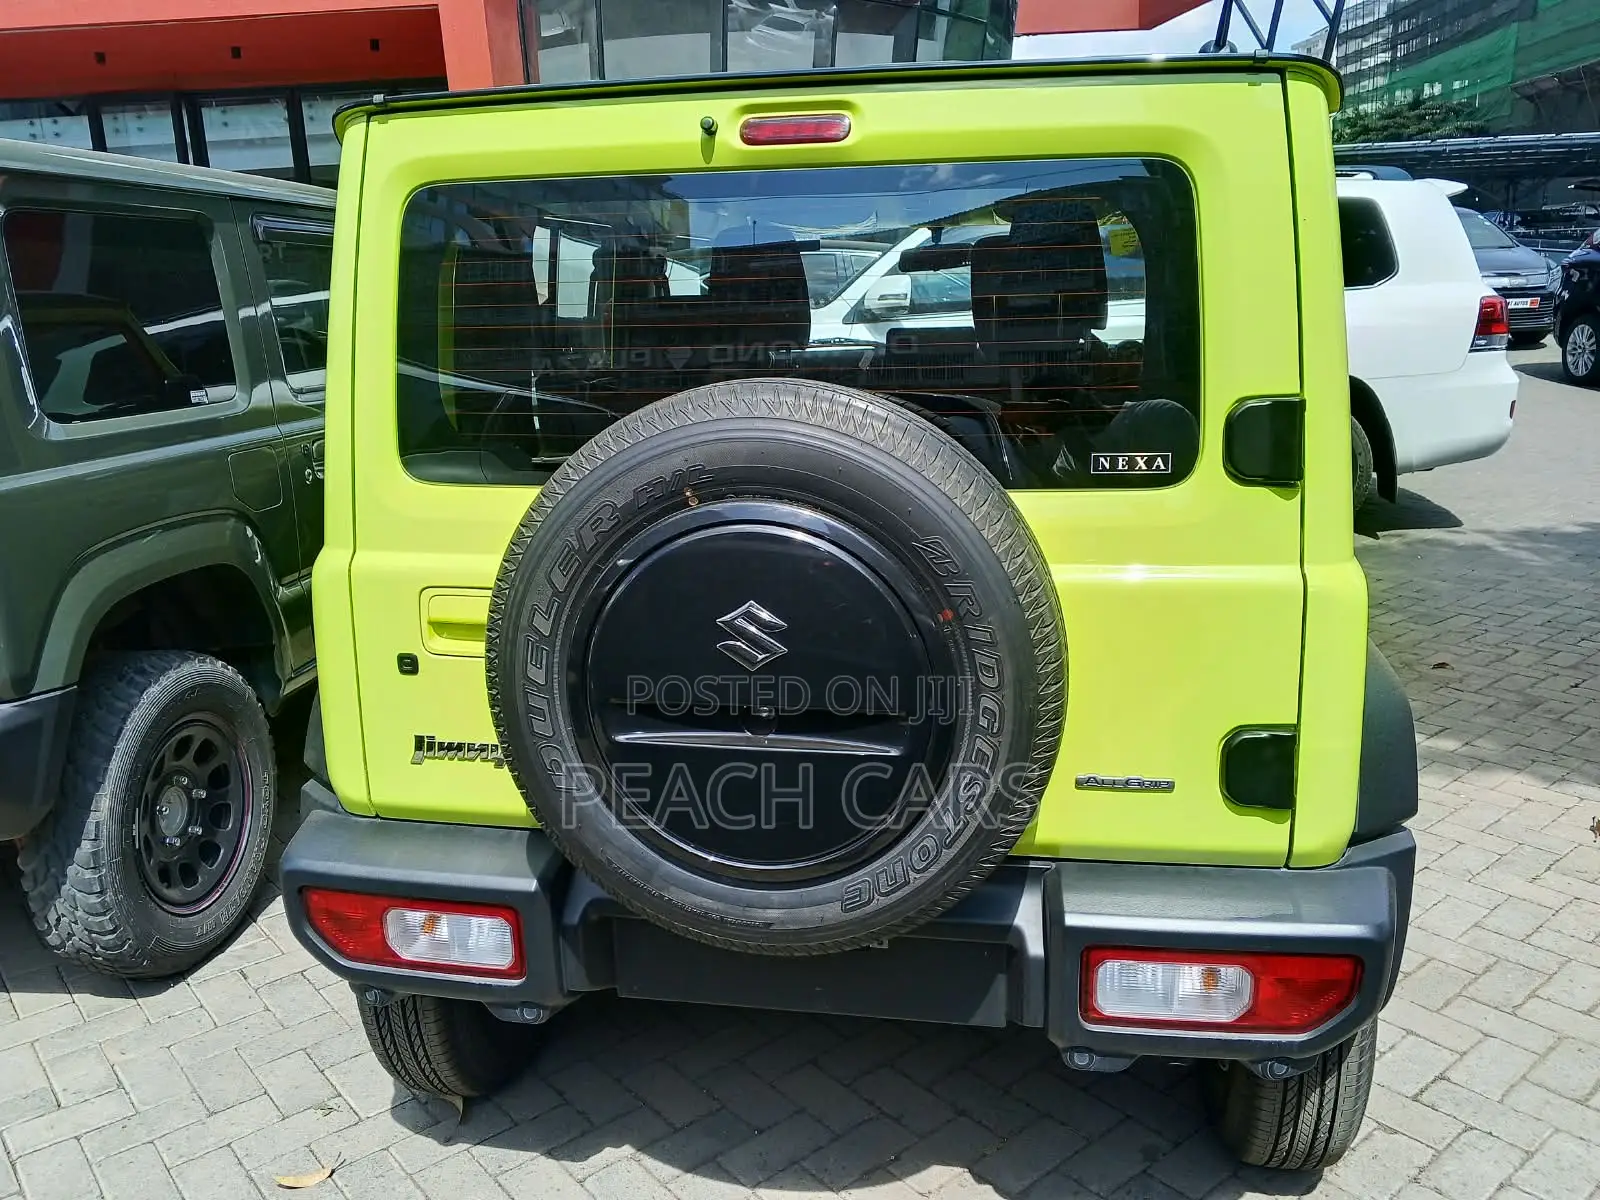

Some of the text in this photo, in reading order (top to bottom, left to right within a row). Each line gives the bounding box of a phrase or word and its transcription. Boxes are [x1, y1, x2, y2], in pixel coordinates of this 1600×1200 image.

[1098, 456, 1166, 470] NEXA
[524, 499, 622, 792] DUELER
[841, 535, 1004, 914] BRIDGESTONE
[410, 734, 506, 769] Jimny
[1083, 775, 1172, 790] ALLGRIP
